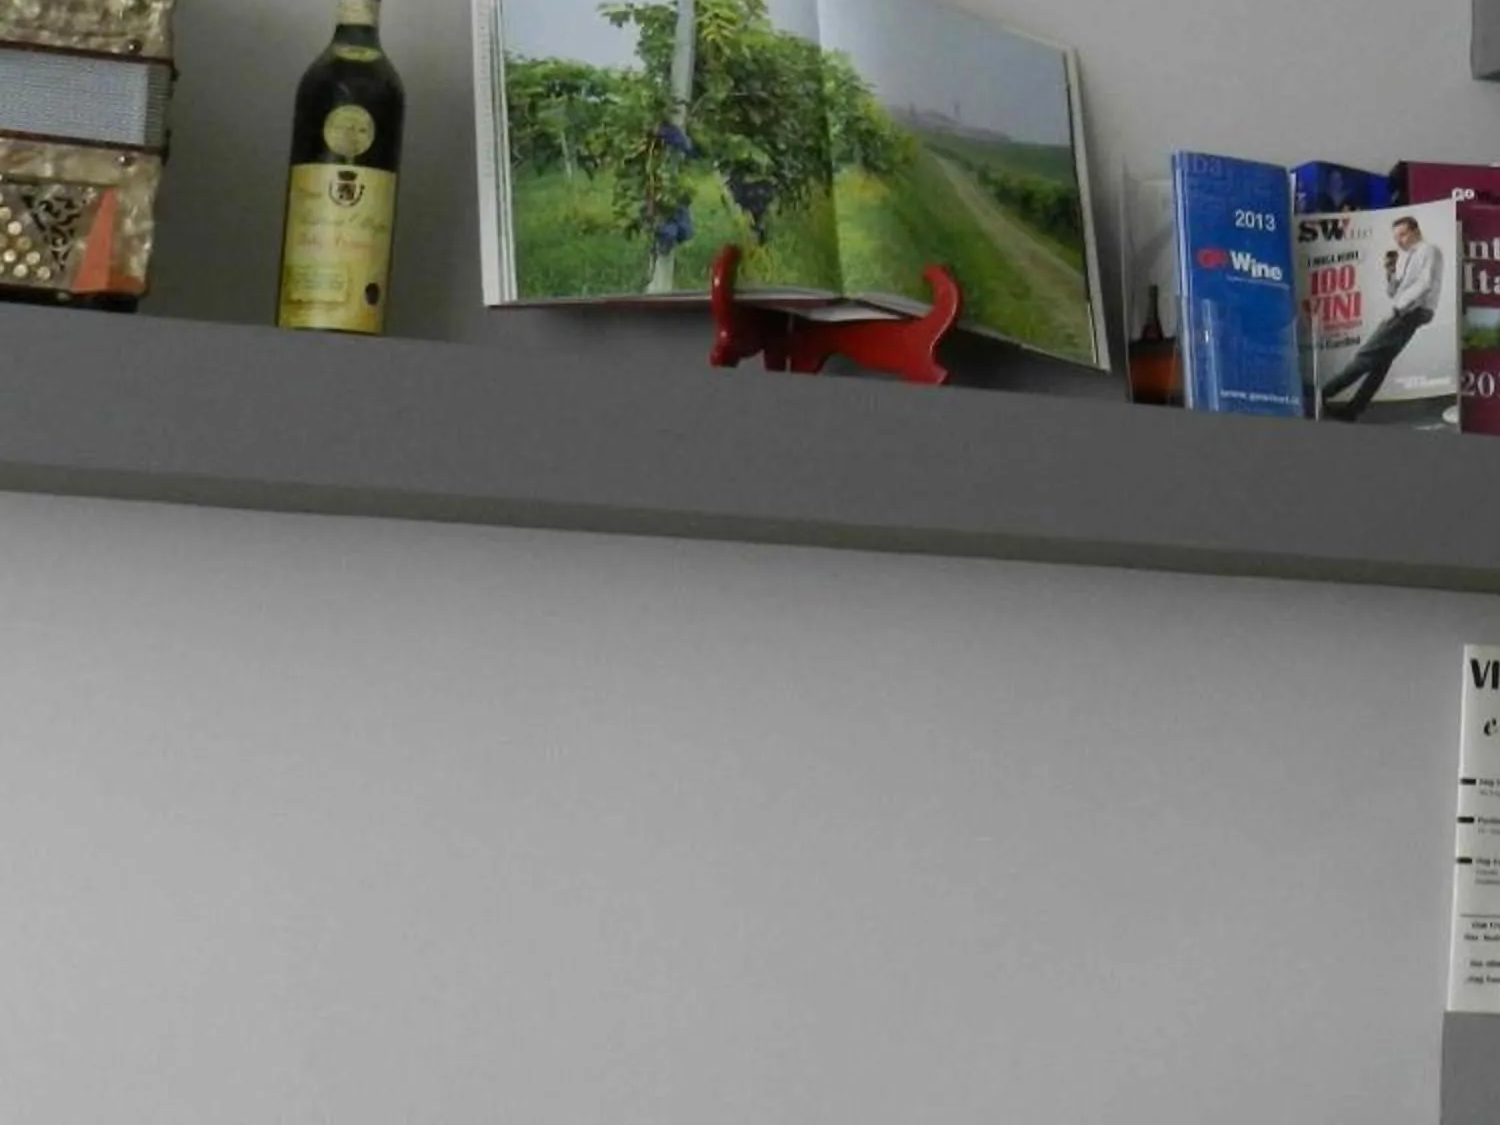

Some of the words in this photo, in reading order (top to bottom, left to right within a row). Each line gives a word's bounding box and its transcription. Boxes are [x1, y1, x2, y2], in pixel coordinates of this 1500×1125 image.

[1234, 209, 1277, 233] 2013
[1229, 249, 1284, 282] Wine
[1309, 263, 1357, 295] 100
[1303, 291, 1363, 323] VINI
